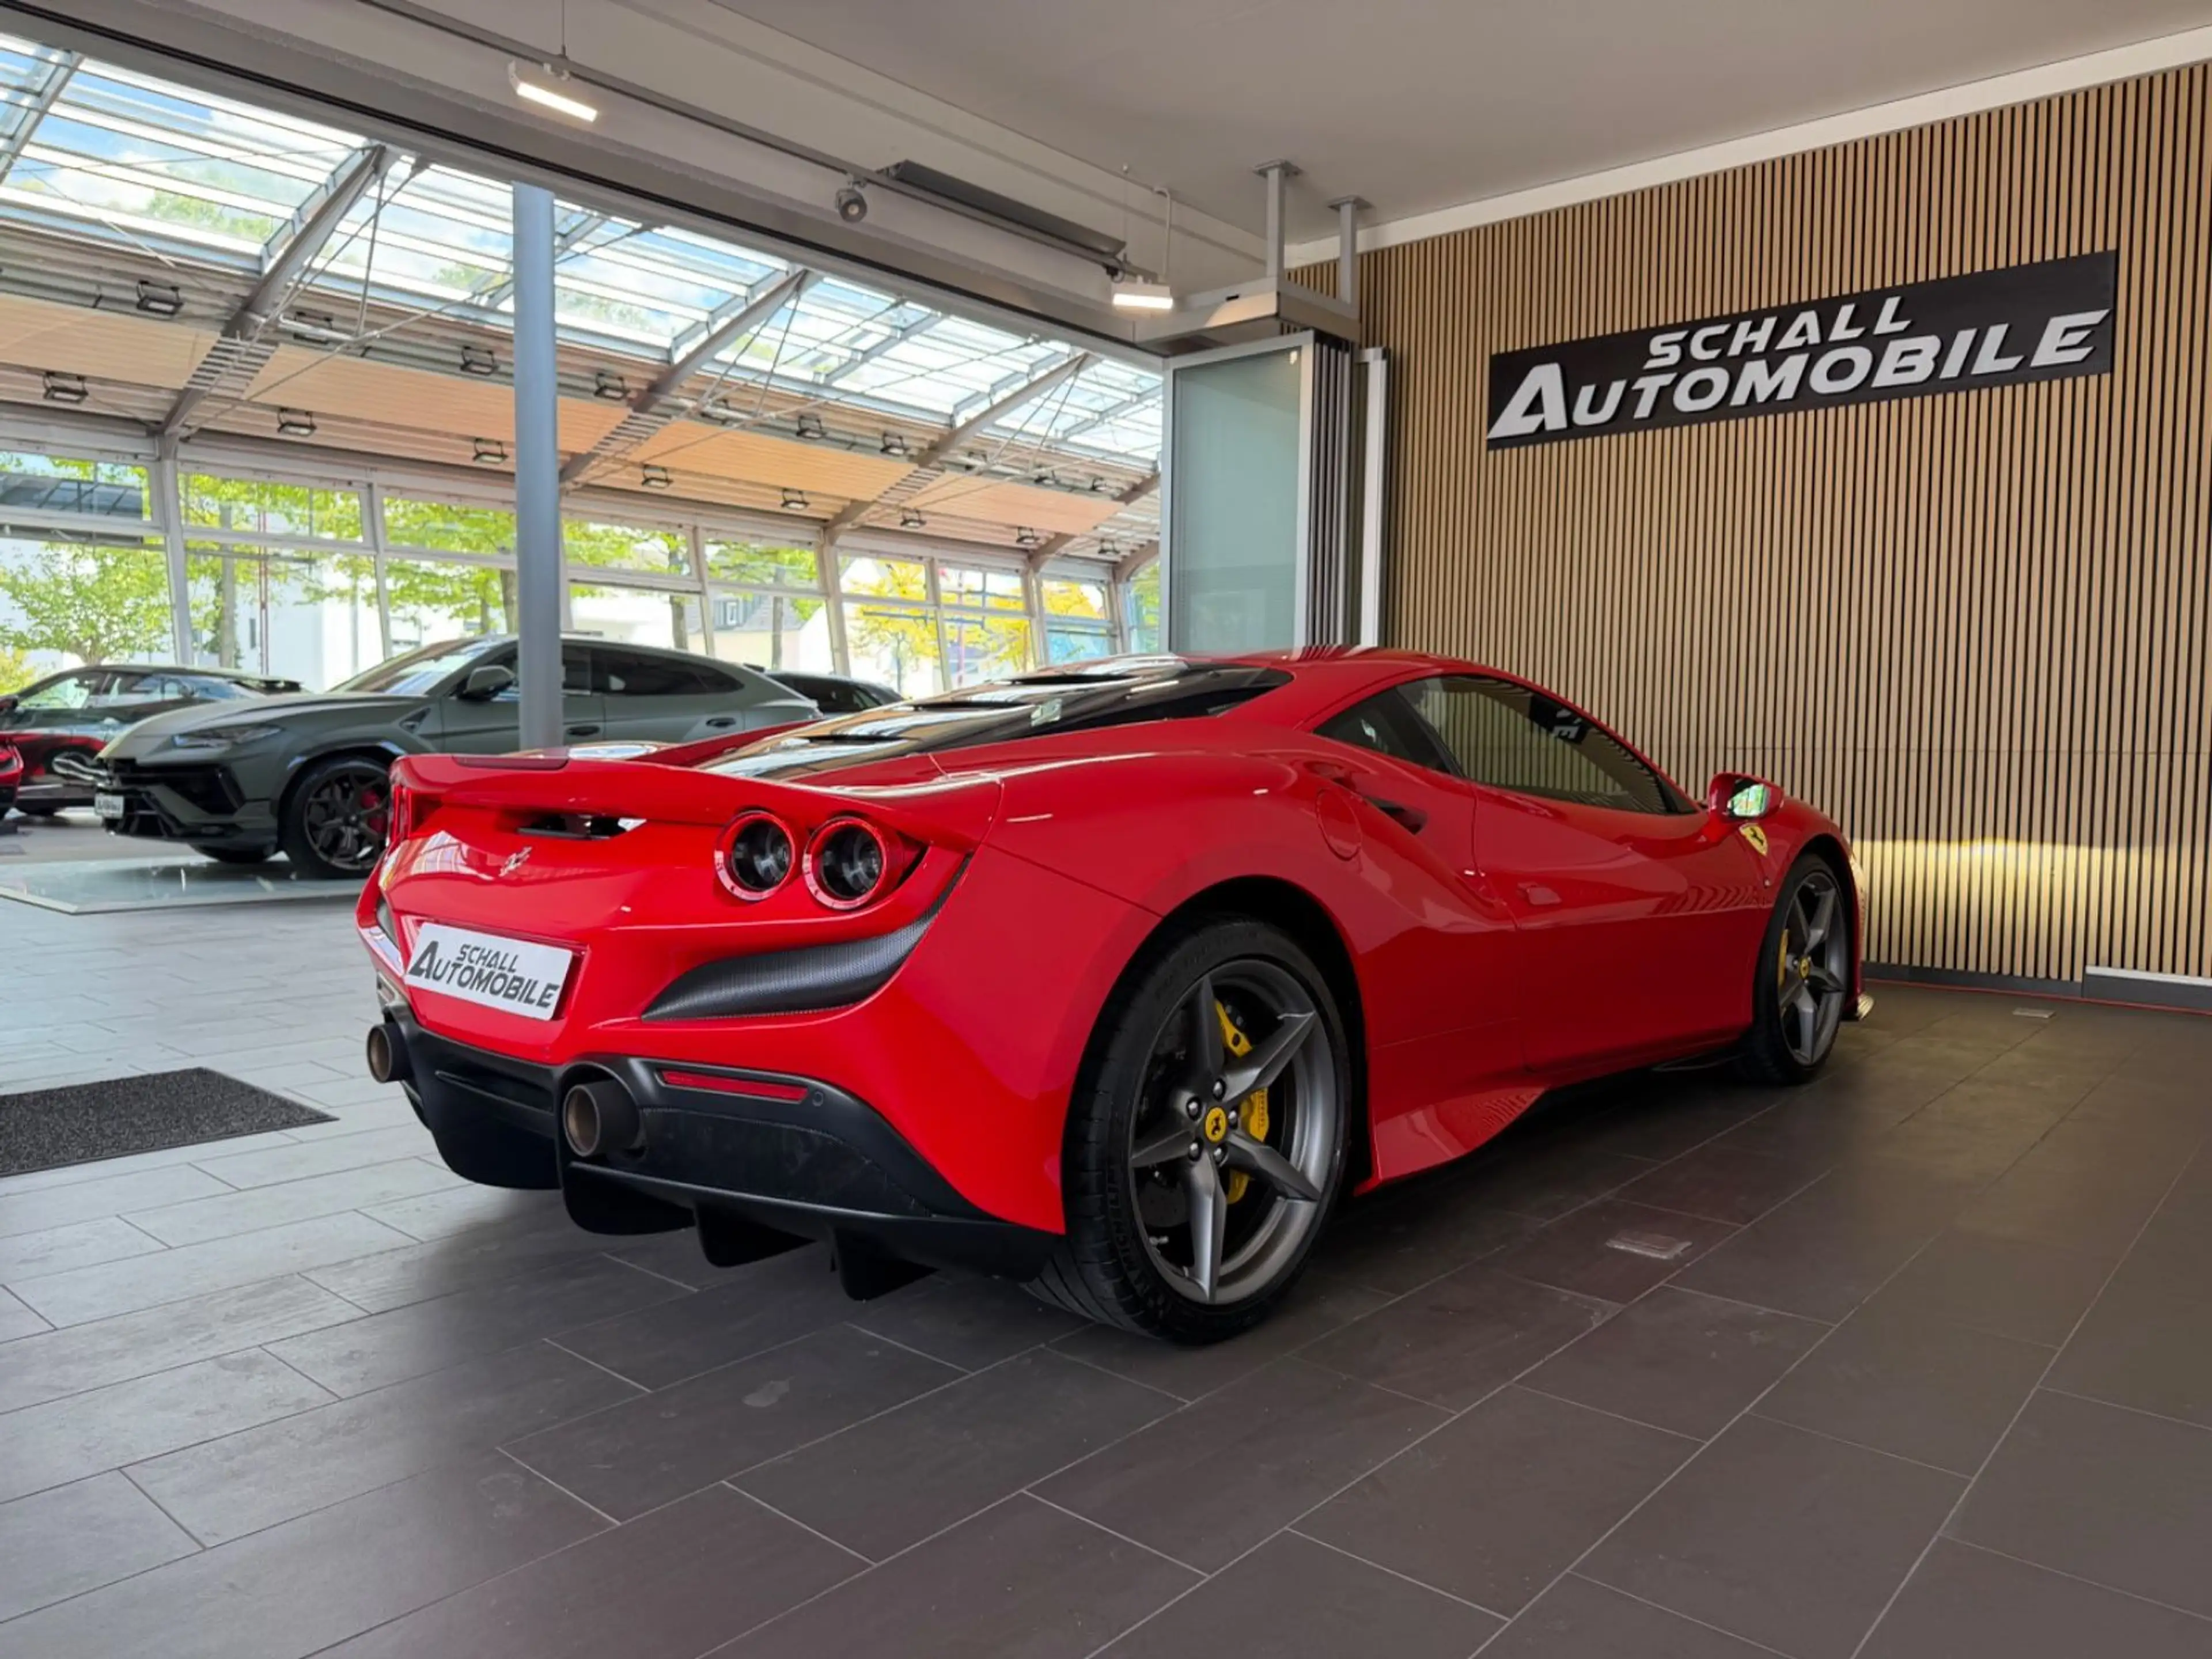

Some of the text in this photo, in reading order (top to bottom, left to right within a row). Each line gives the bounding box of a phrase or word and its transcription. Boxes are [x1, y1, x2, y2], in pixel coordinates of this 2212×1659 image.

[1643, 296, 1911, 369] SCHALL
[1486, 309, 2111, 440] AUTOMOBILE
[408, 940, 560, 1008] AUTOMOBILE
[456, 944, 518, 972] SCHALL
